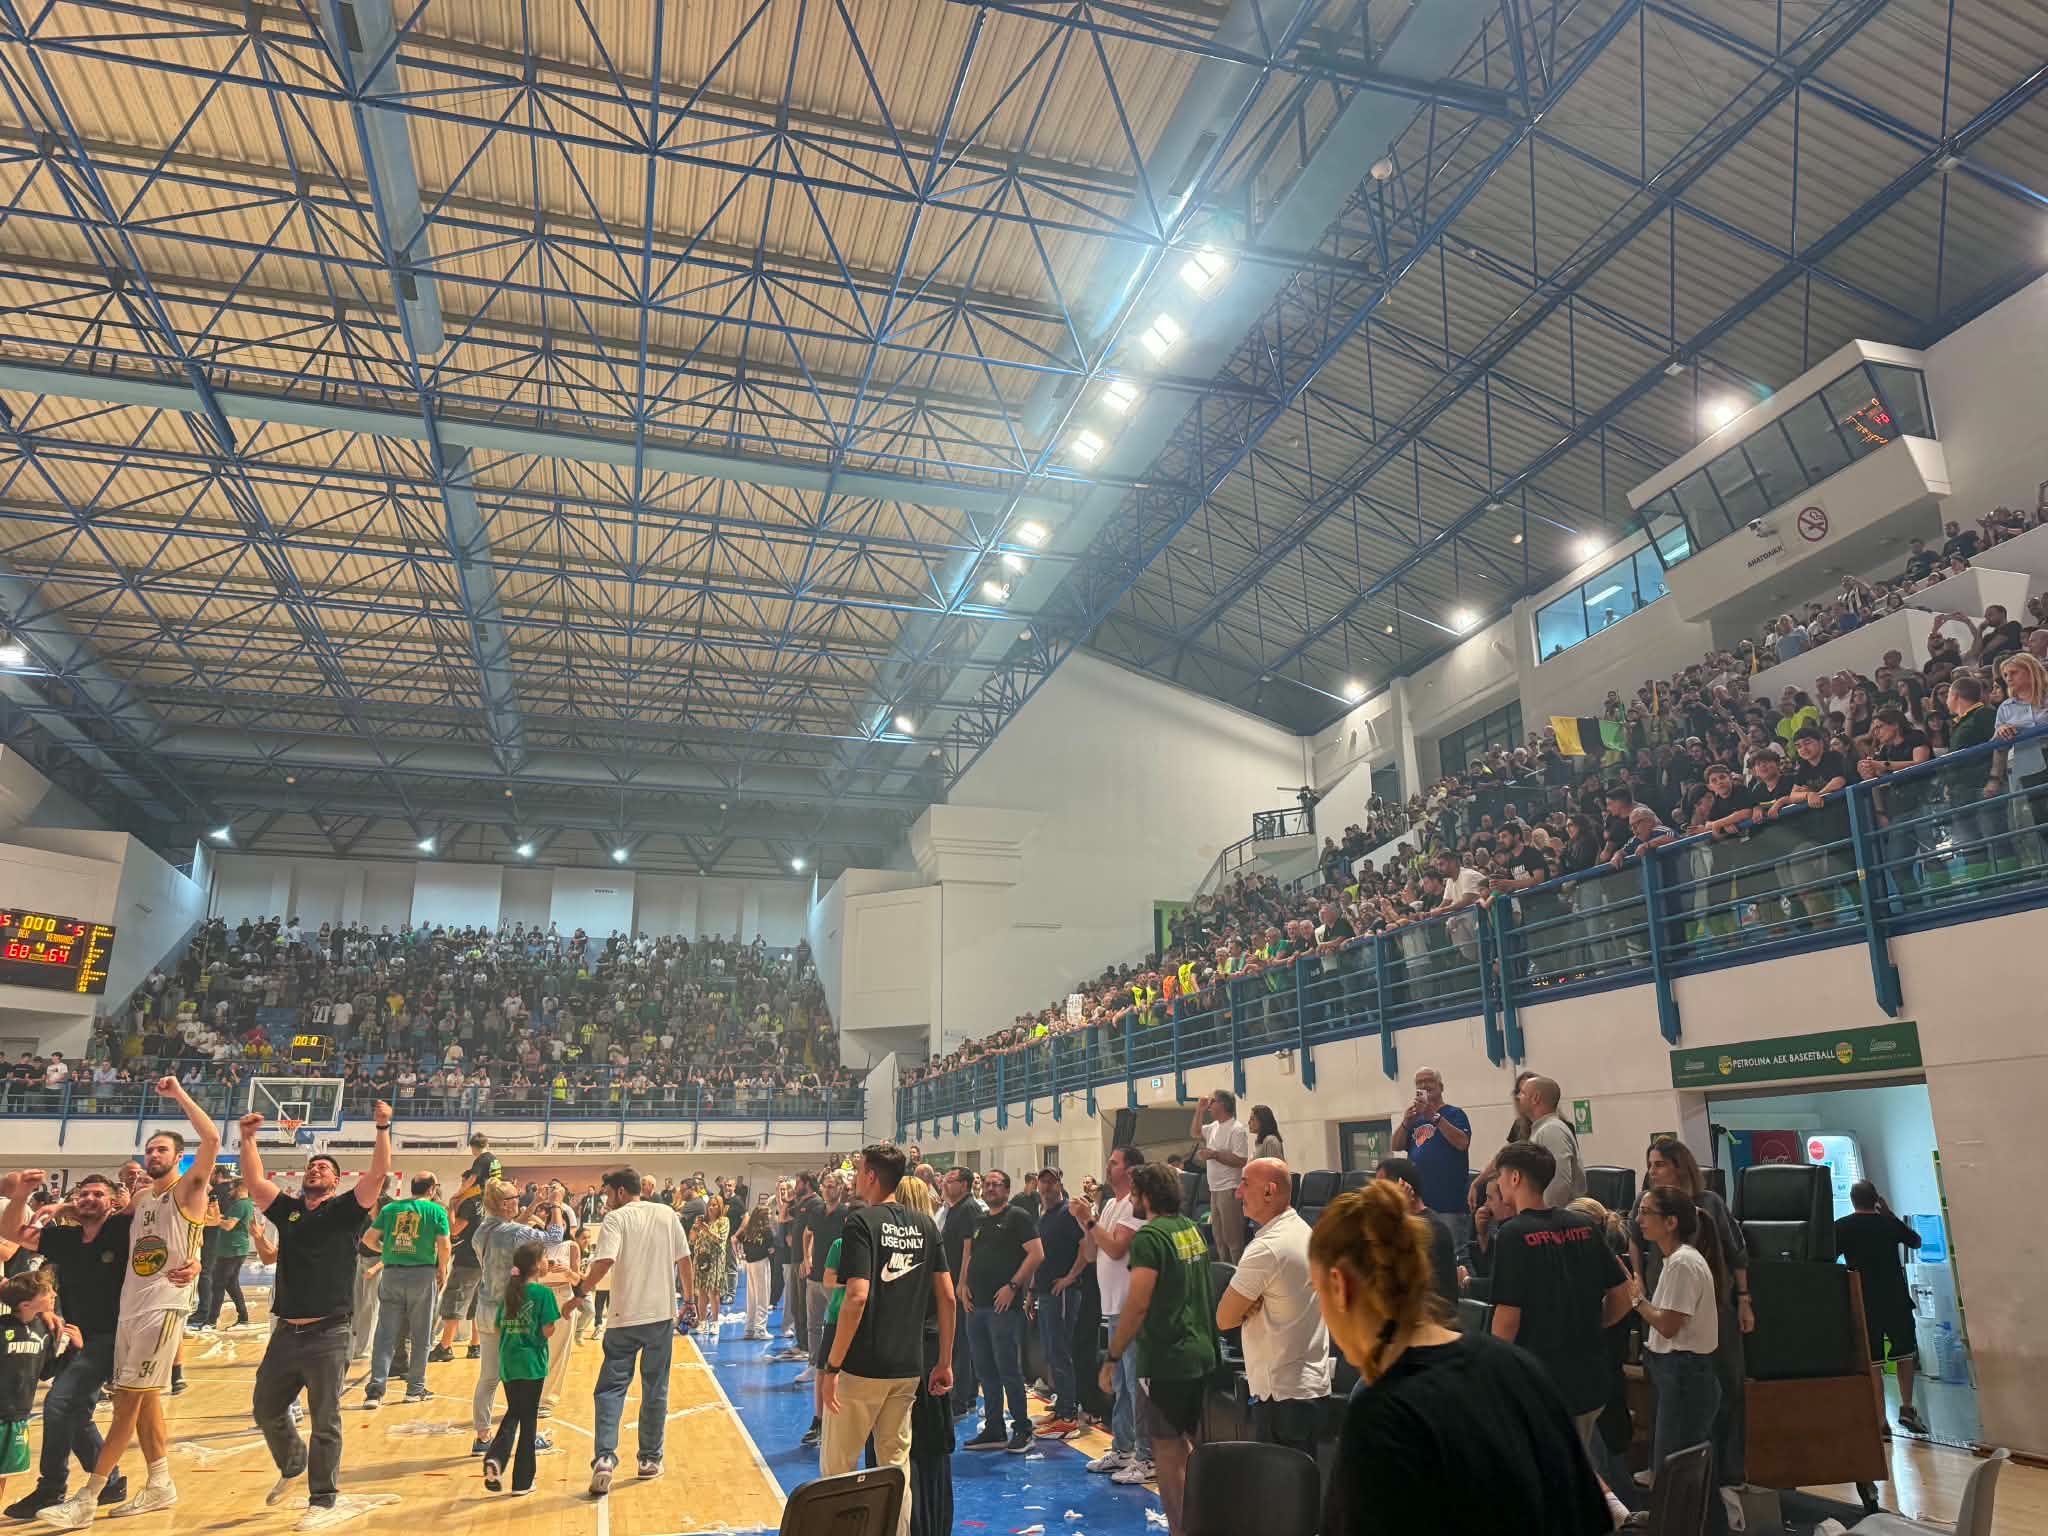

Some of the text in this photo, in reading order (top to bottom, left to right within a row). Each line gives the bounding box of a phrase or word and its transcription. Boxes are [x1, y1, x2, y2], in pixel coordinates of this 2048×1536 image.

[48, 948, 69, 963] 64
[1732, 1057, 1771, 1069] PETROLINA
[1773, 1055, 1788, 1065] AEK
[1789, 1049, 1836, 1064] BASKETBALL
[143, 1209, 156, 1227] 34
[899, 1238, 924, 1249] ONLY
[888, 1252, 914, 1270] NIKE
[138, 1360, 158, 1379] 34
